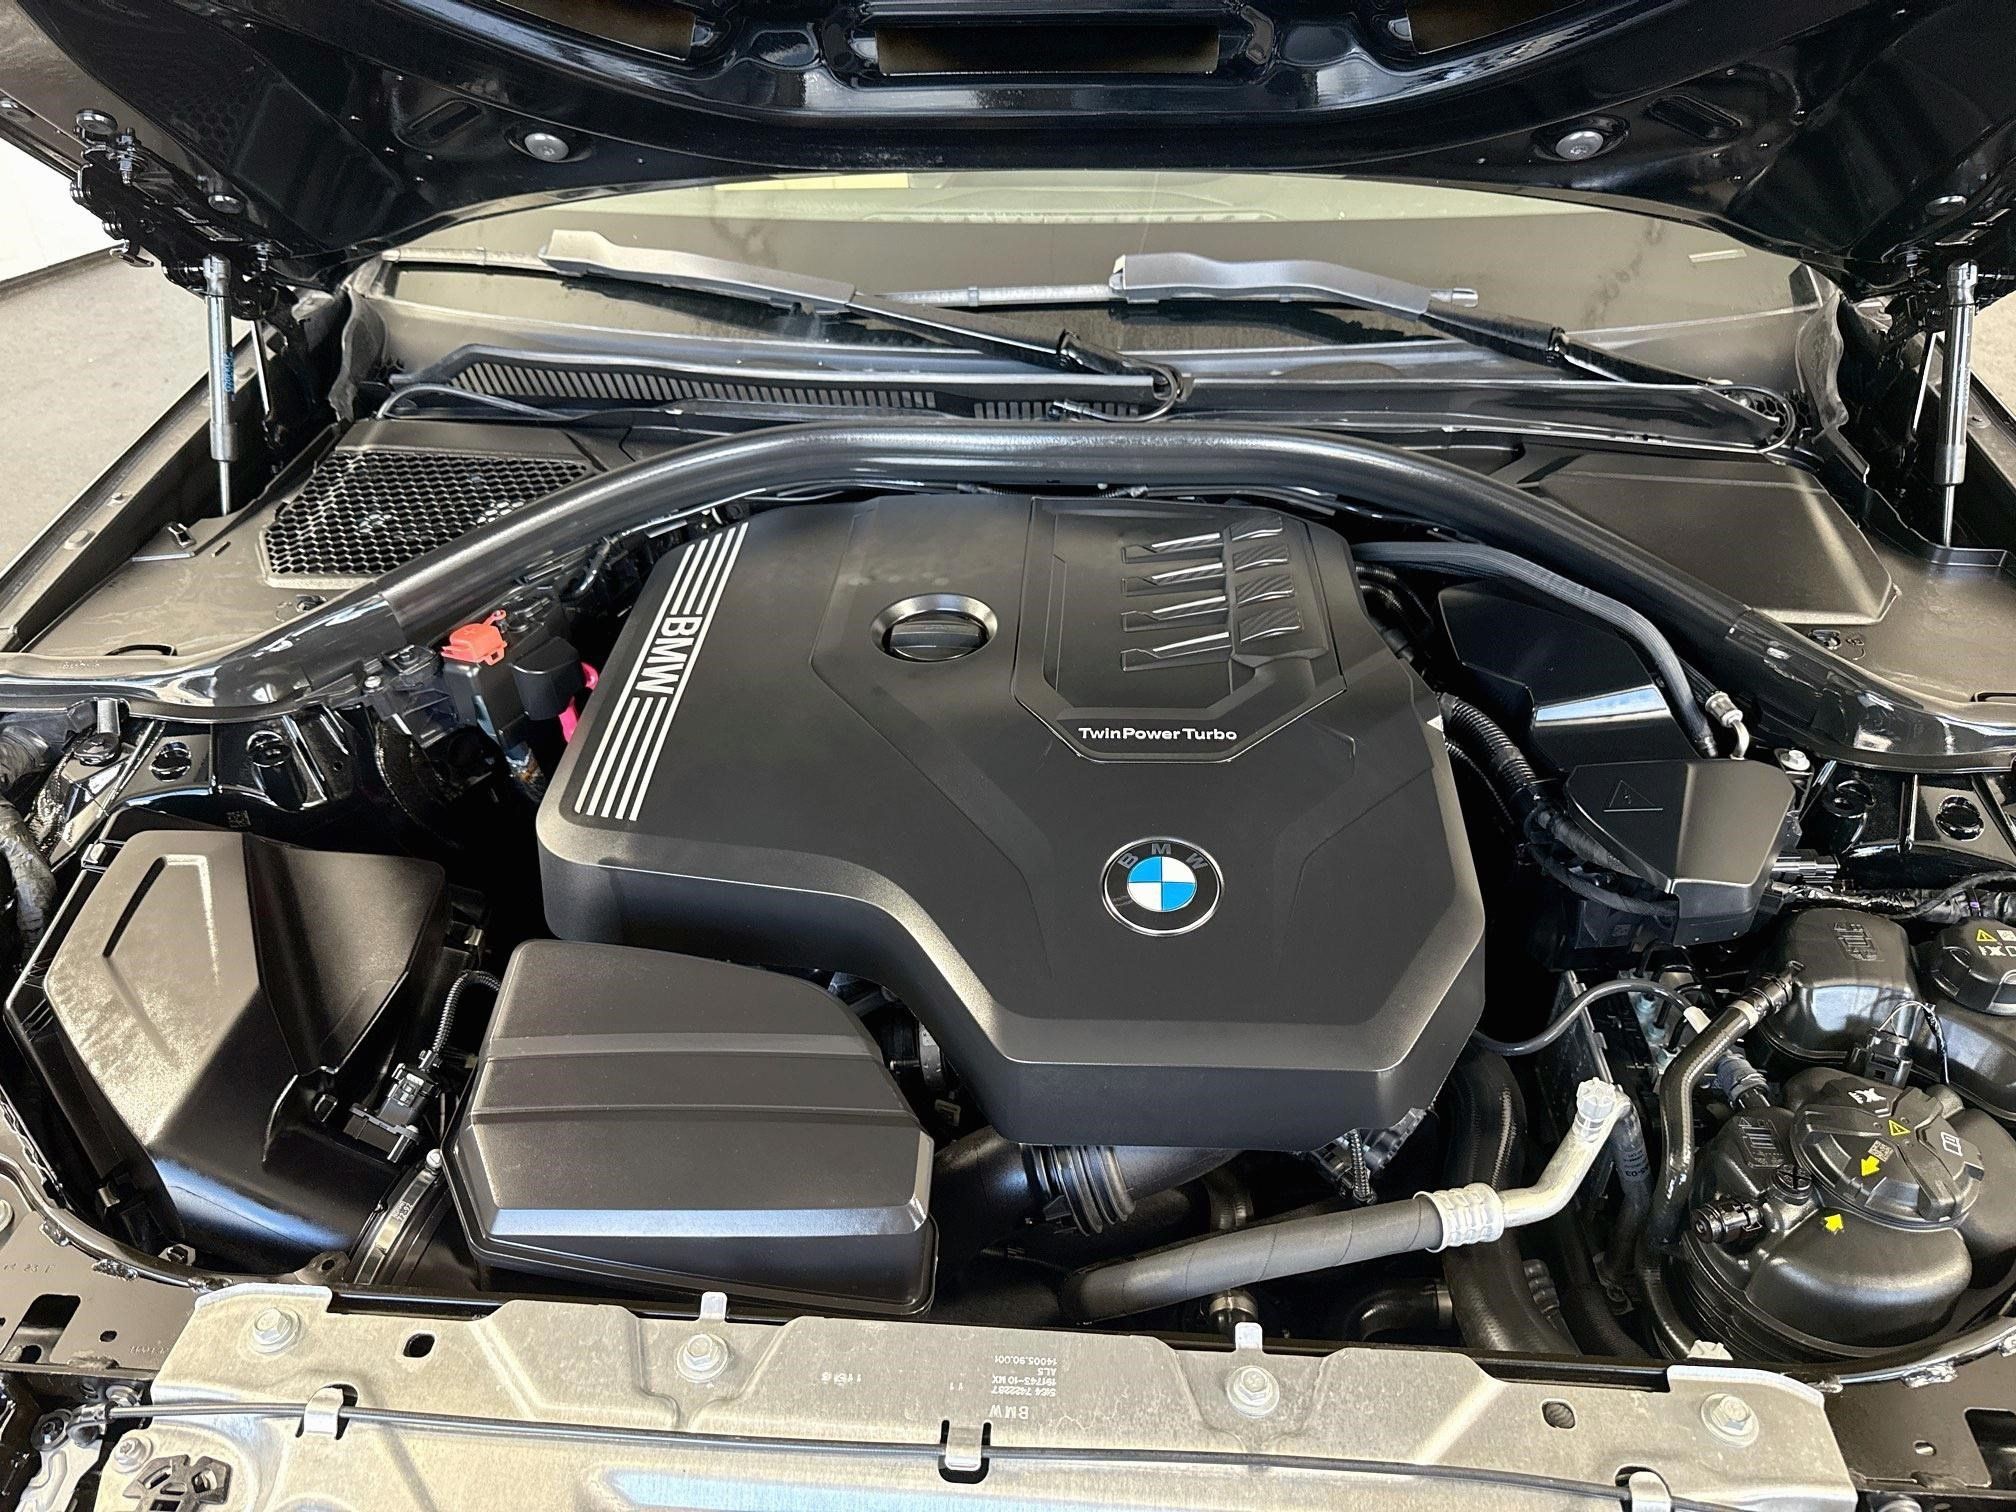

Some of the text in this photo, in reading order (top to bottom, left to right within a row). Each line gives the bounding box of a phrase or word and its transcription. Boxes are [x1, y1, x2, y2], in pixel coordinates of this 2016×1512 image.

[635, 616, 703, 695] BMW
[1117, 843, 1208, 870] BMW
[989, 1404, 1029, 1419] BMW
